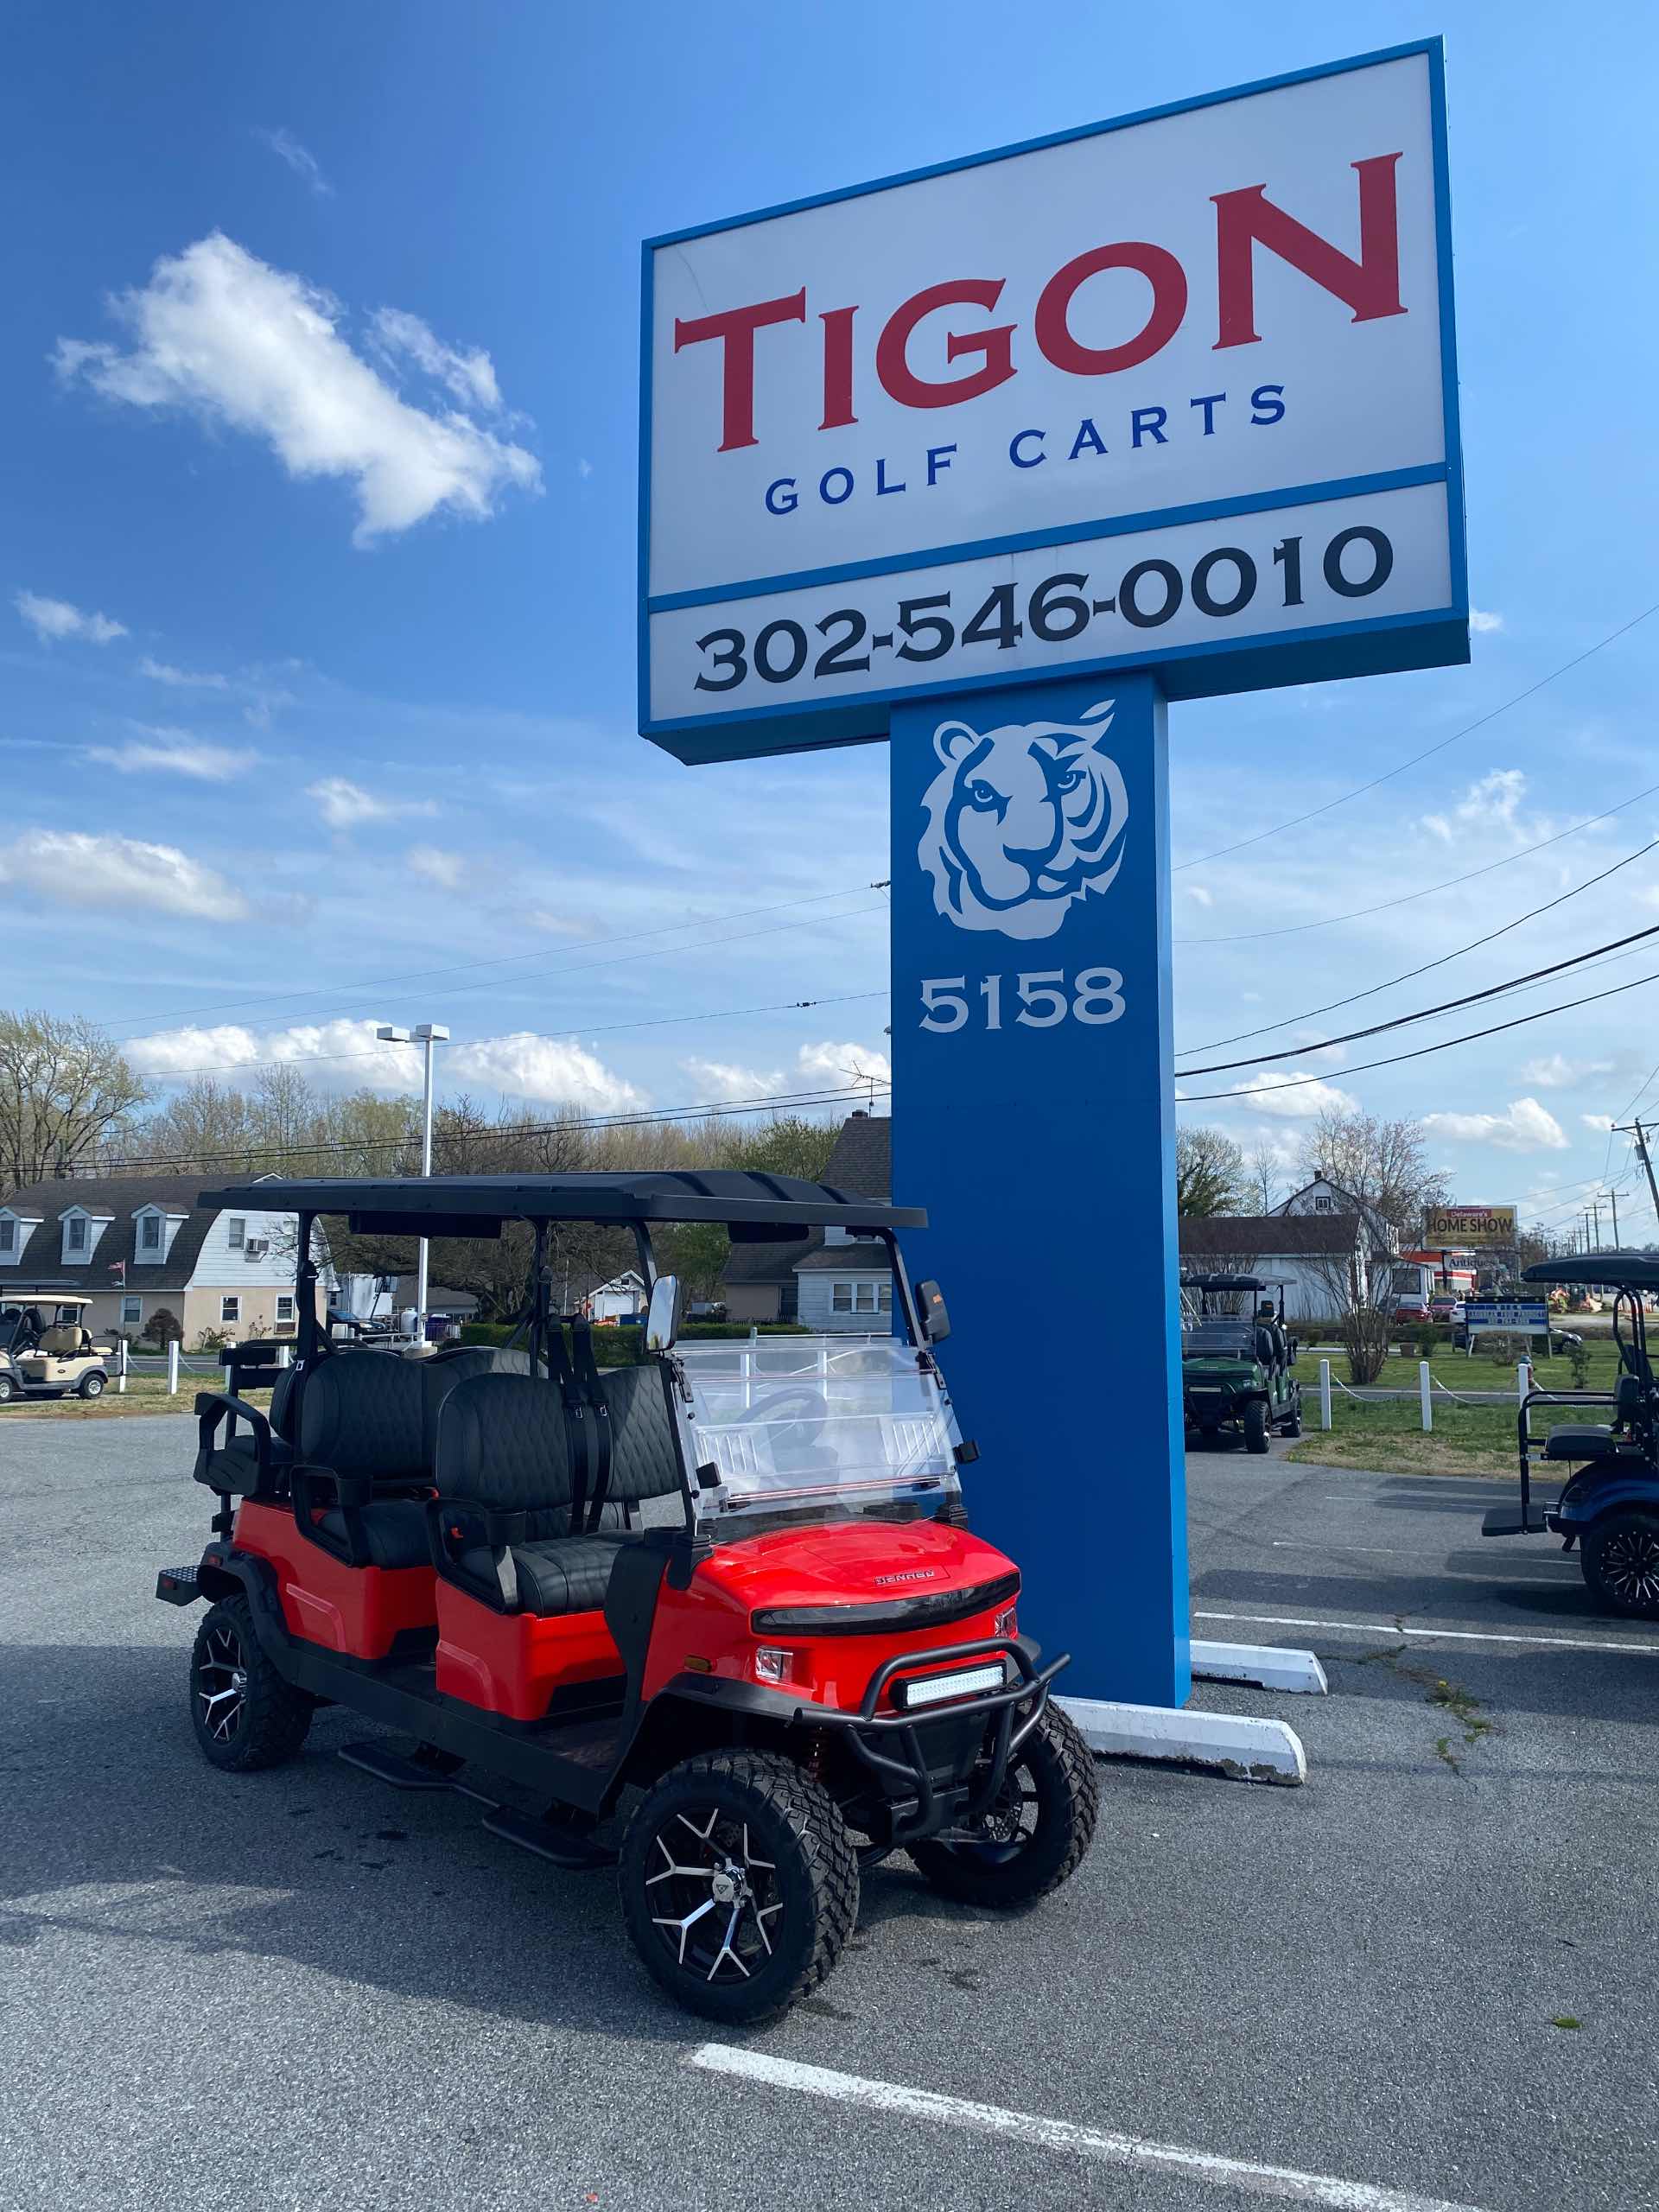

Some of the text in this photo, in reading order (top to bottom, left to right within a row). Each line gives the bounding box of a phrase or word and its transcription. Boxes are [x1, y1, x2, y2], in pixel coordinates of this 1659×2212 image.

[674, 151, 1408, 452] TIGON
[765, 383, 1287, 516] GOLF CARTS
[693, 524, 1395, 693] 302-546-0010
[918, 967, 1126, 1033] 5158
[1470, 1218, 1512, 1232] SHOW
